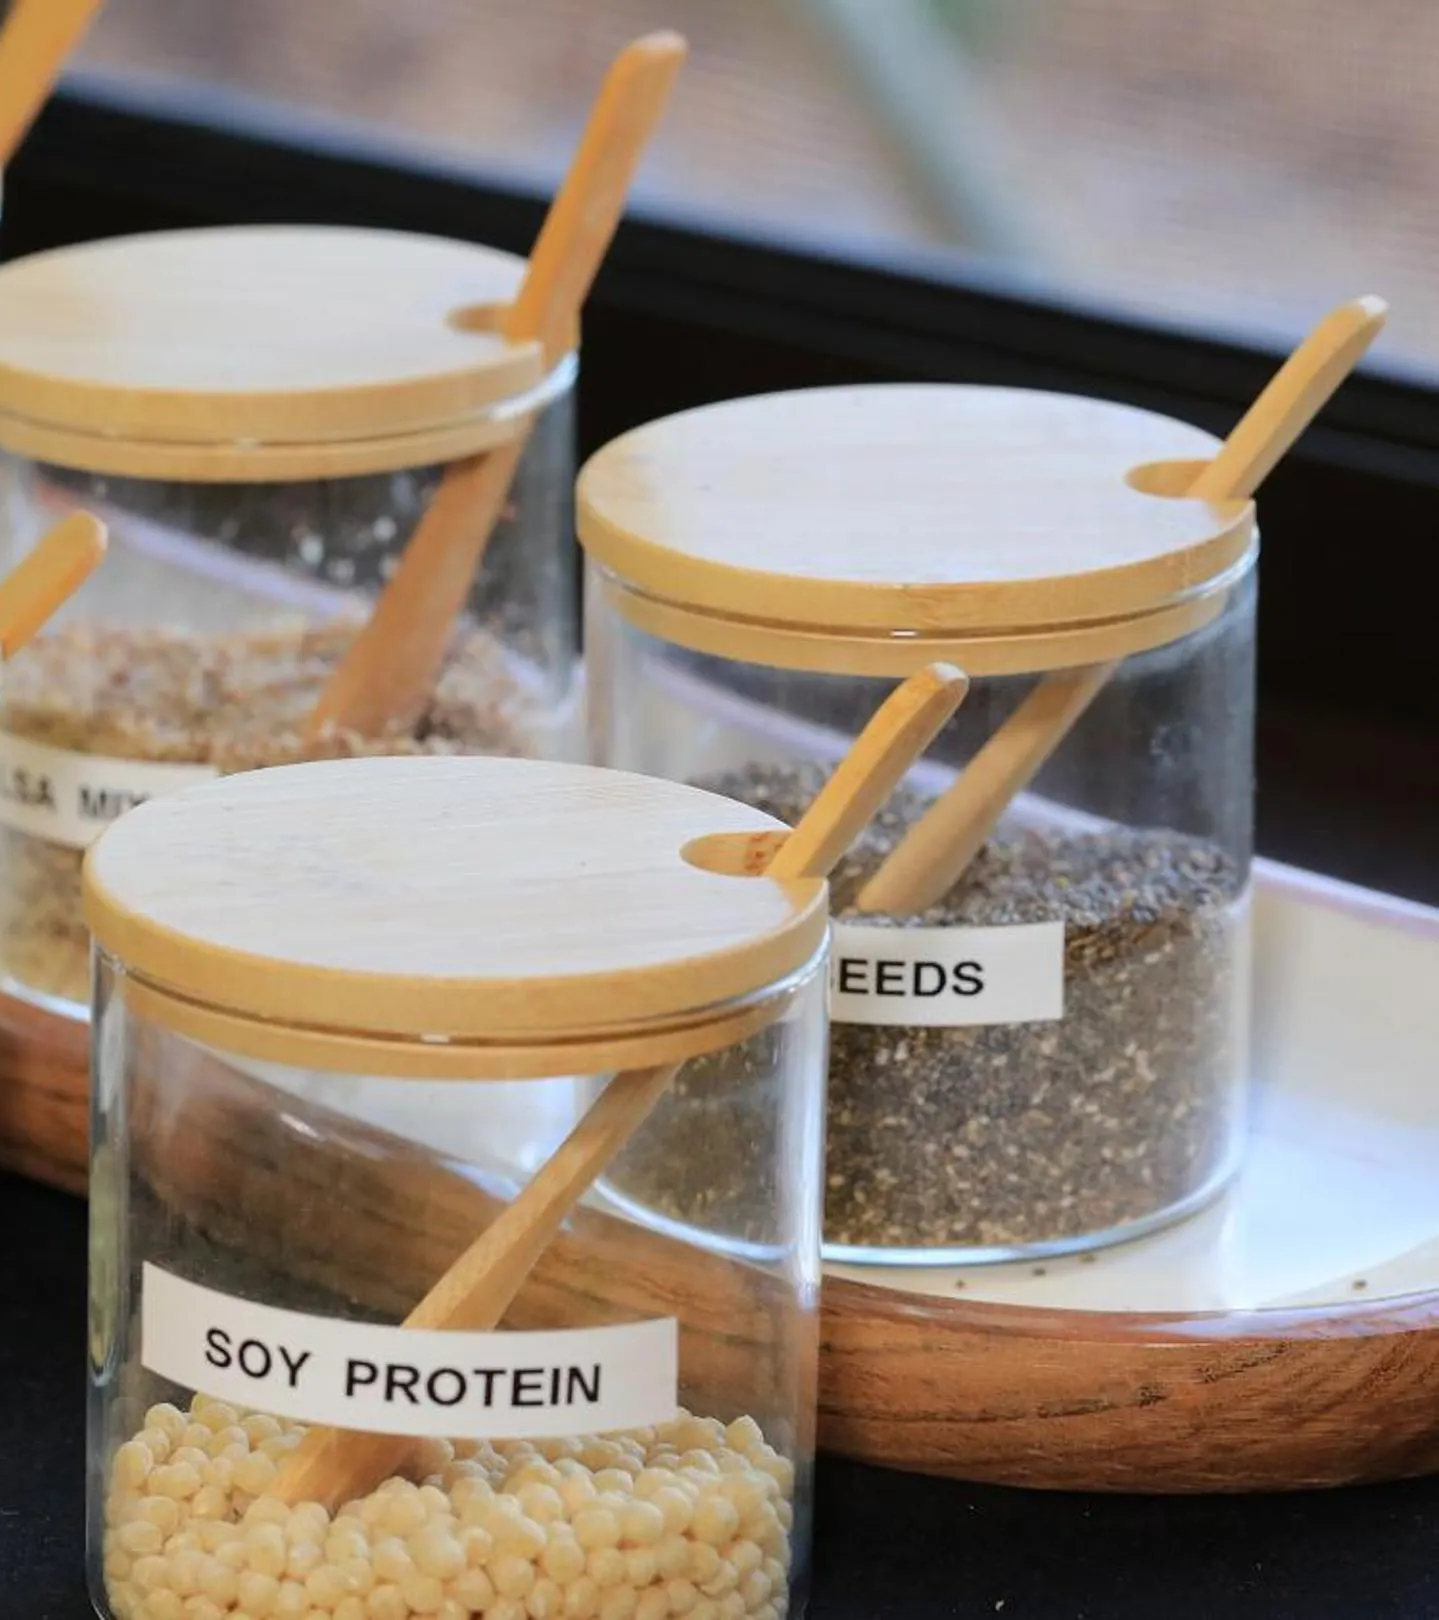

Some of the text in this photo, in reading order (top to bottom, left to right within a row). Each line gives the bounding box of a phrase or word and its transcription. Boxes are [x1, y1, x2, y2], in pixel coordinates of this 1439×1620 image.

[830, 957, 984, 997] EEDS
[205, 1327, 602, 1408] SOY PROTEIN
